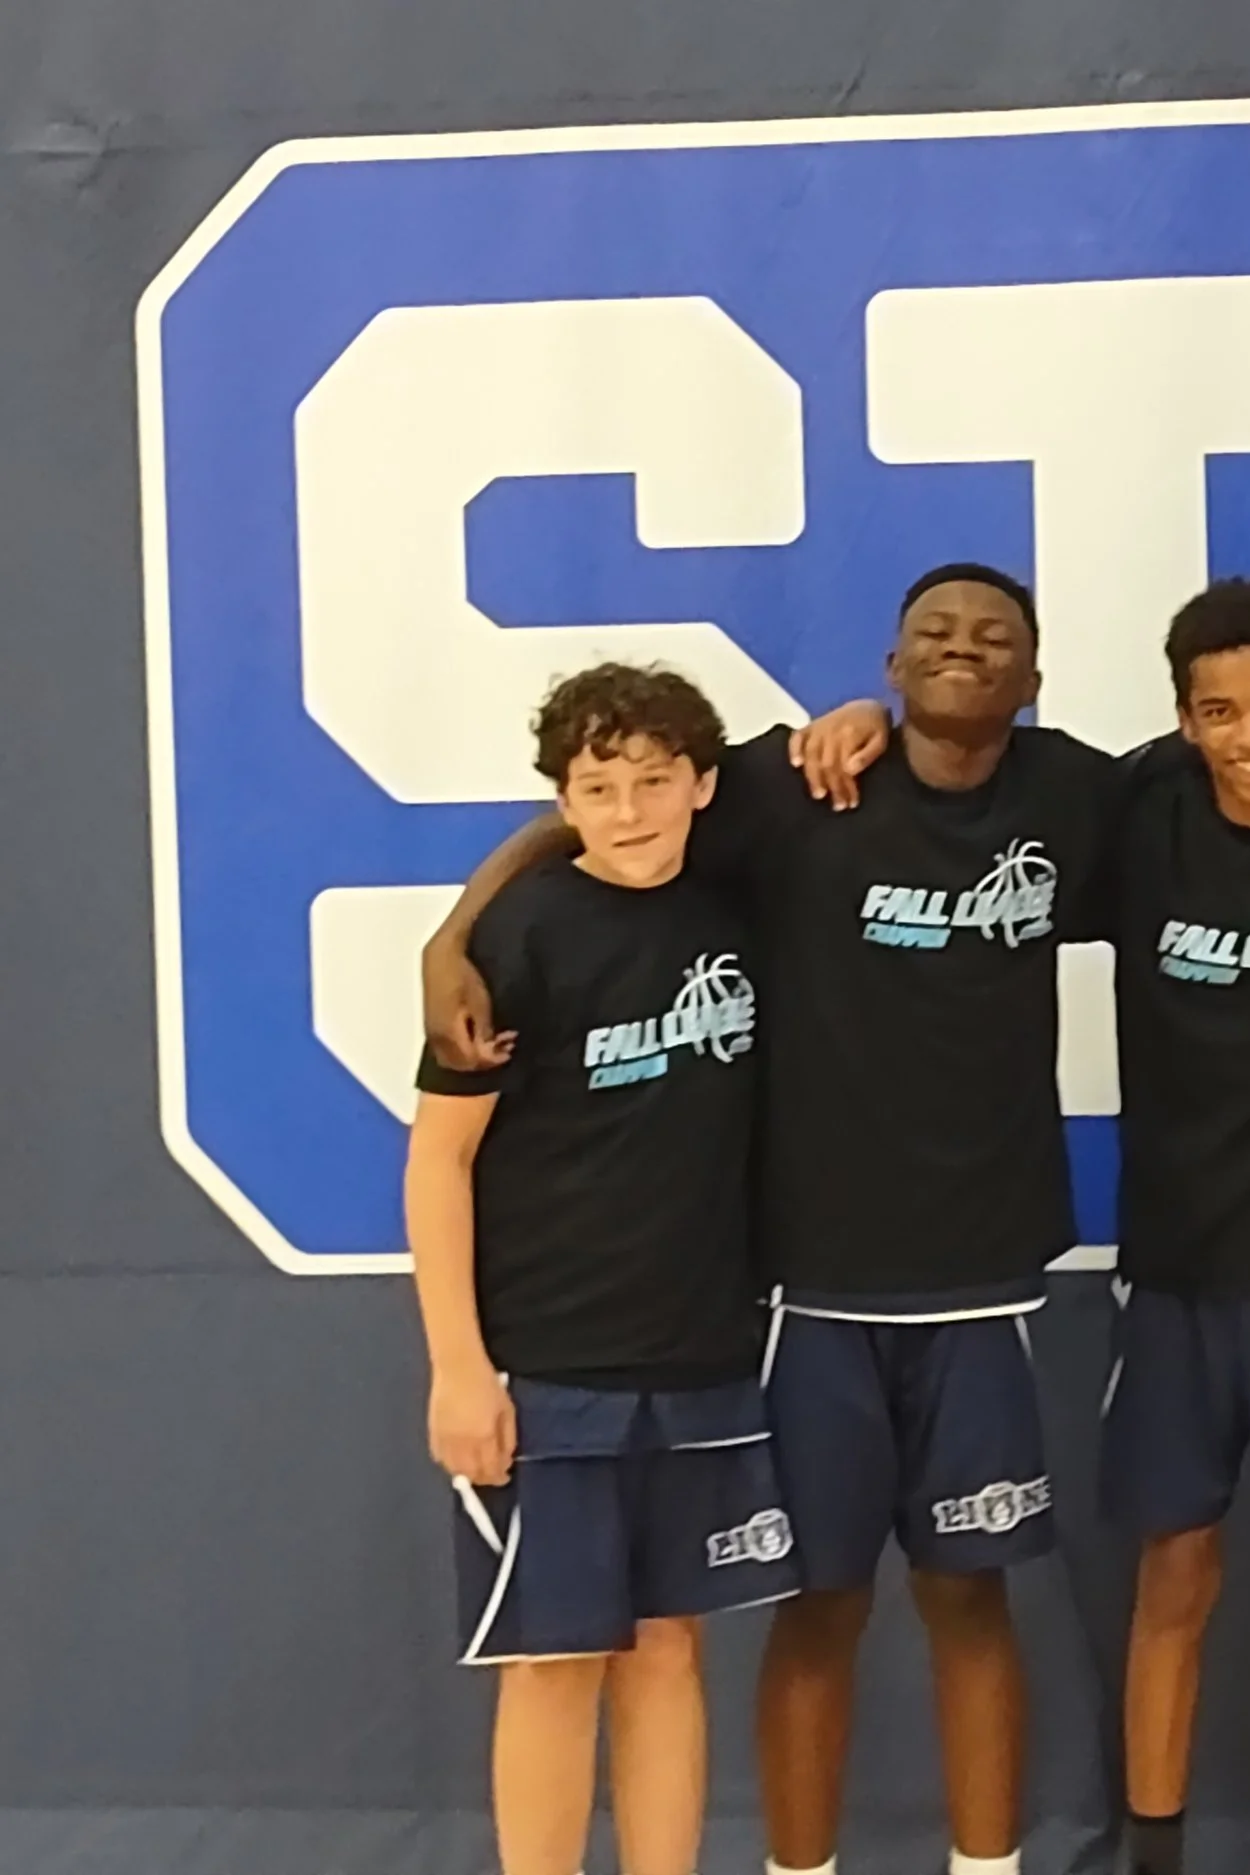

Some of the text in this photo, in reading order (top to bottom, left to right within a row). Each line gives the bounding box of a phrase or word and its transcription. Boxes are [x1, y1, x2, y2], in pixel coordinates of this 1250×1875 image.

[860, 884, 949, 925] FALL
[1157, 920, 1239, 965] FALL
[584, 1018, 662, 1068] FALL
